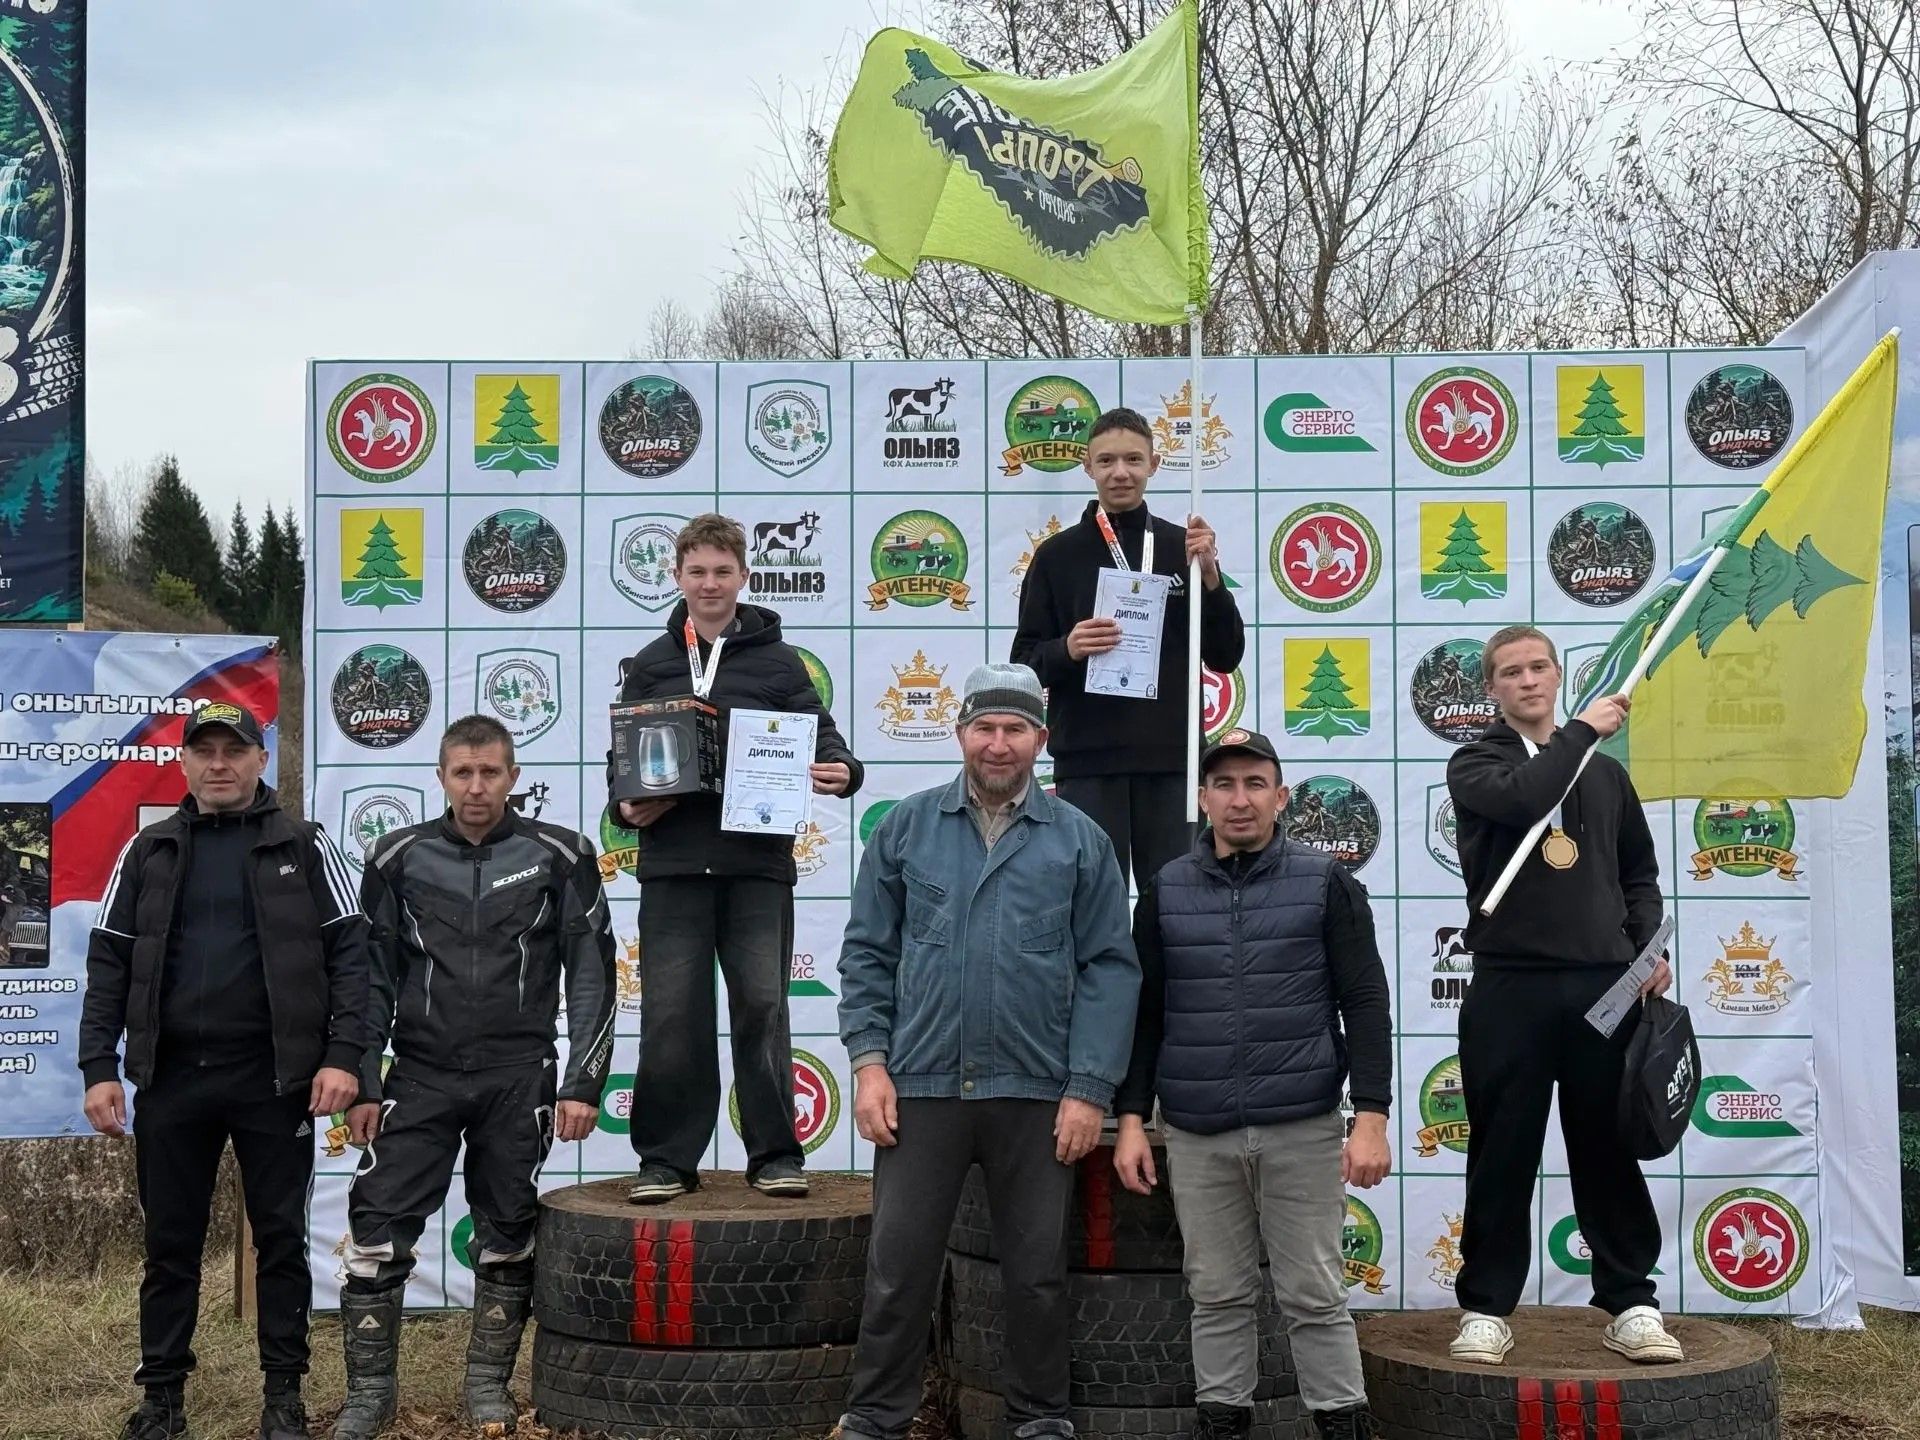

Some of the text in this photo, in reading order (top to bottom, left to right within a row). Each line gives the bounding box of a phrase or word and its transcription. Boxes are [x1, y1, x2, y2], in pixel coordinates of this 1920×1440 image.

[1292, 410, 1354, 423] ЭНЕРГО
[1292, 423, 1355, 435] СЕРВИС
[1709, 428, 1771, 446] ОЛЫЯЗ
[621, 439, 681, 455] ОЛЫЯЗ
[884, 437, 960, 459] ОЛЫЯЗ
[1719, 441, 1762, 451] ЭНДУРО
[632, 450, 671, 459] ЭНДУРО
[752, 444, 795, 467] Сабинский
[904, 460, 943, 468] Ахметов
[945, 460, 959, 468] Г.Р.
[1571, 566, 1633, 583] ОЛЫЯЗ
[484, 574, 546, 589] ОЛЫЯЗ
[748, 571, 826, 594] ОЛЫЯЗ
[886, 576, 953, 595] ИГЕНЧЕ
[1581, 578, 1624, 588] ЭНДУРО
[496, 583, 537, 594] ЭНДУРО
[617, 579, 660, 601] Сабинский
[1114, 609, 1149, 621] ДИПЛОМ
[350, 708, 410, 725] ОЛЫЯЗ
[1434, 703, 1496, 720] ОЛЫЯЗ
[360, 720, 401, 730] ЭНДУРО
[1444, 716, 1486, 725] ЭНДУРО
[892, 729, 920, 738] Камелия
[748, 748, 794, 759] ДИПЛОМ
[1303, 840, 1359, 853] ЛЫЯЗ
[1432, 847, 1461, 869] Сабинс
[1710, 846, 1781, 866] ИГЕНЧЕ
[492, 865, 539, 888] SCOYCO
[1430, 1001, 1451, 1009] КФХ
[1720, 1002, 1776, 1012] Камелия Мебель
[0, 1032, 57, 1044] ович
[1717, 1094, 1781, 1106] ЭНЕРГО
[1717, 1107, 1783, 1120] СЕРВИС
[1434, 1123, 1469, 1141] ИГЕ
